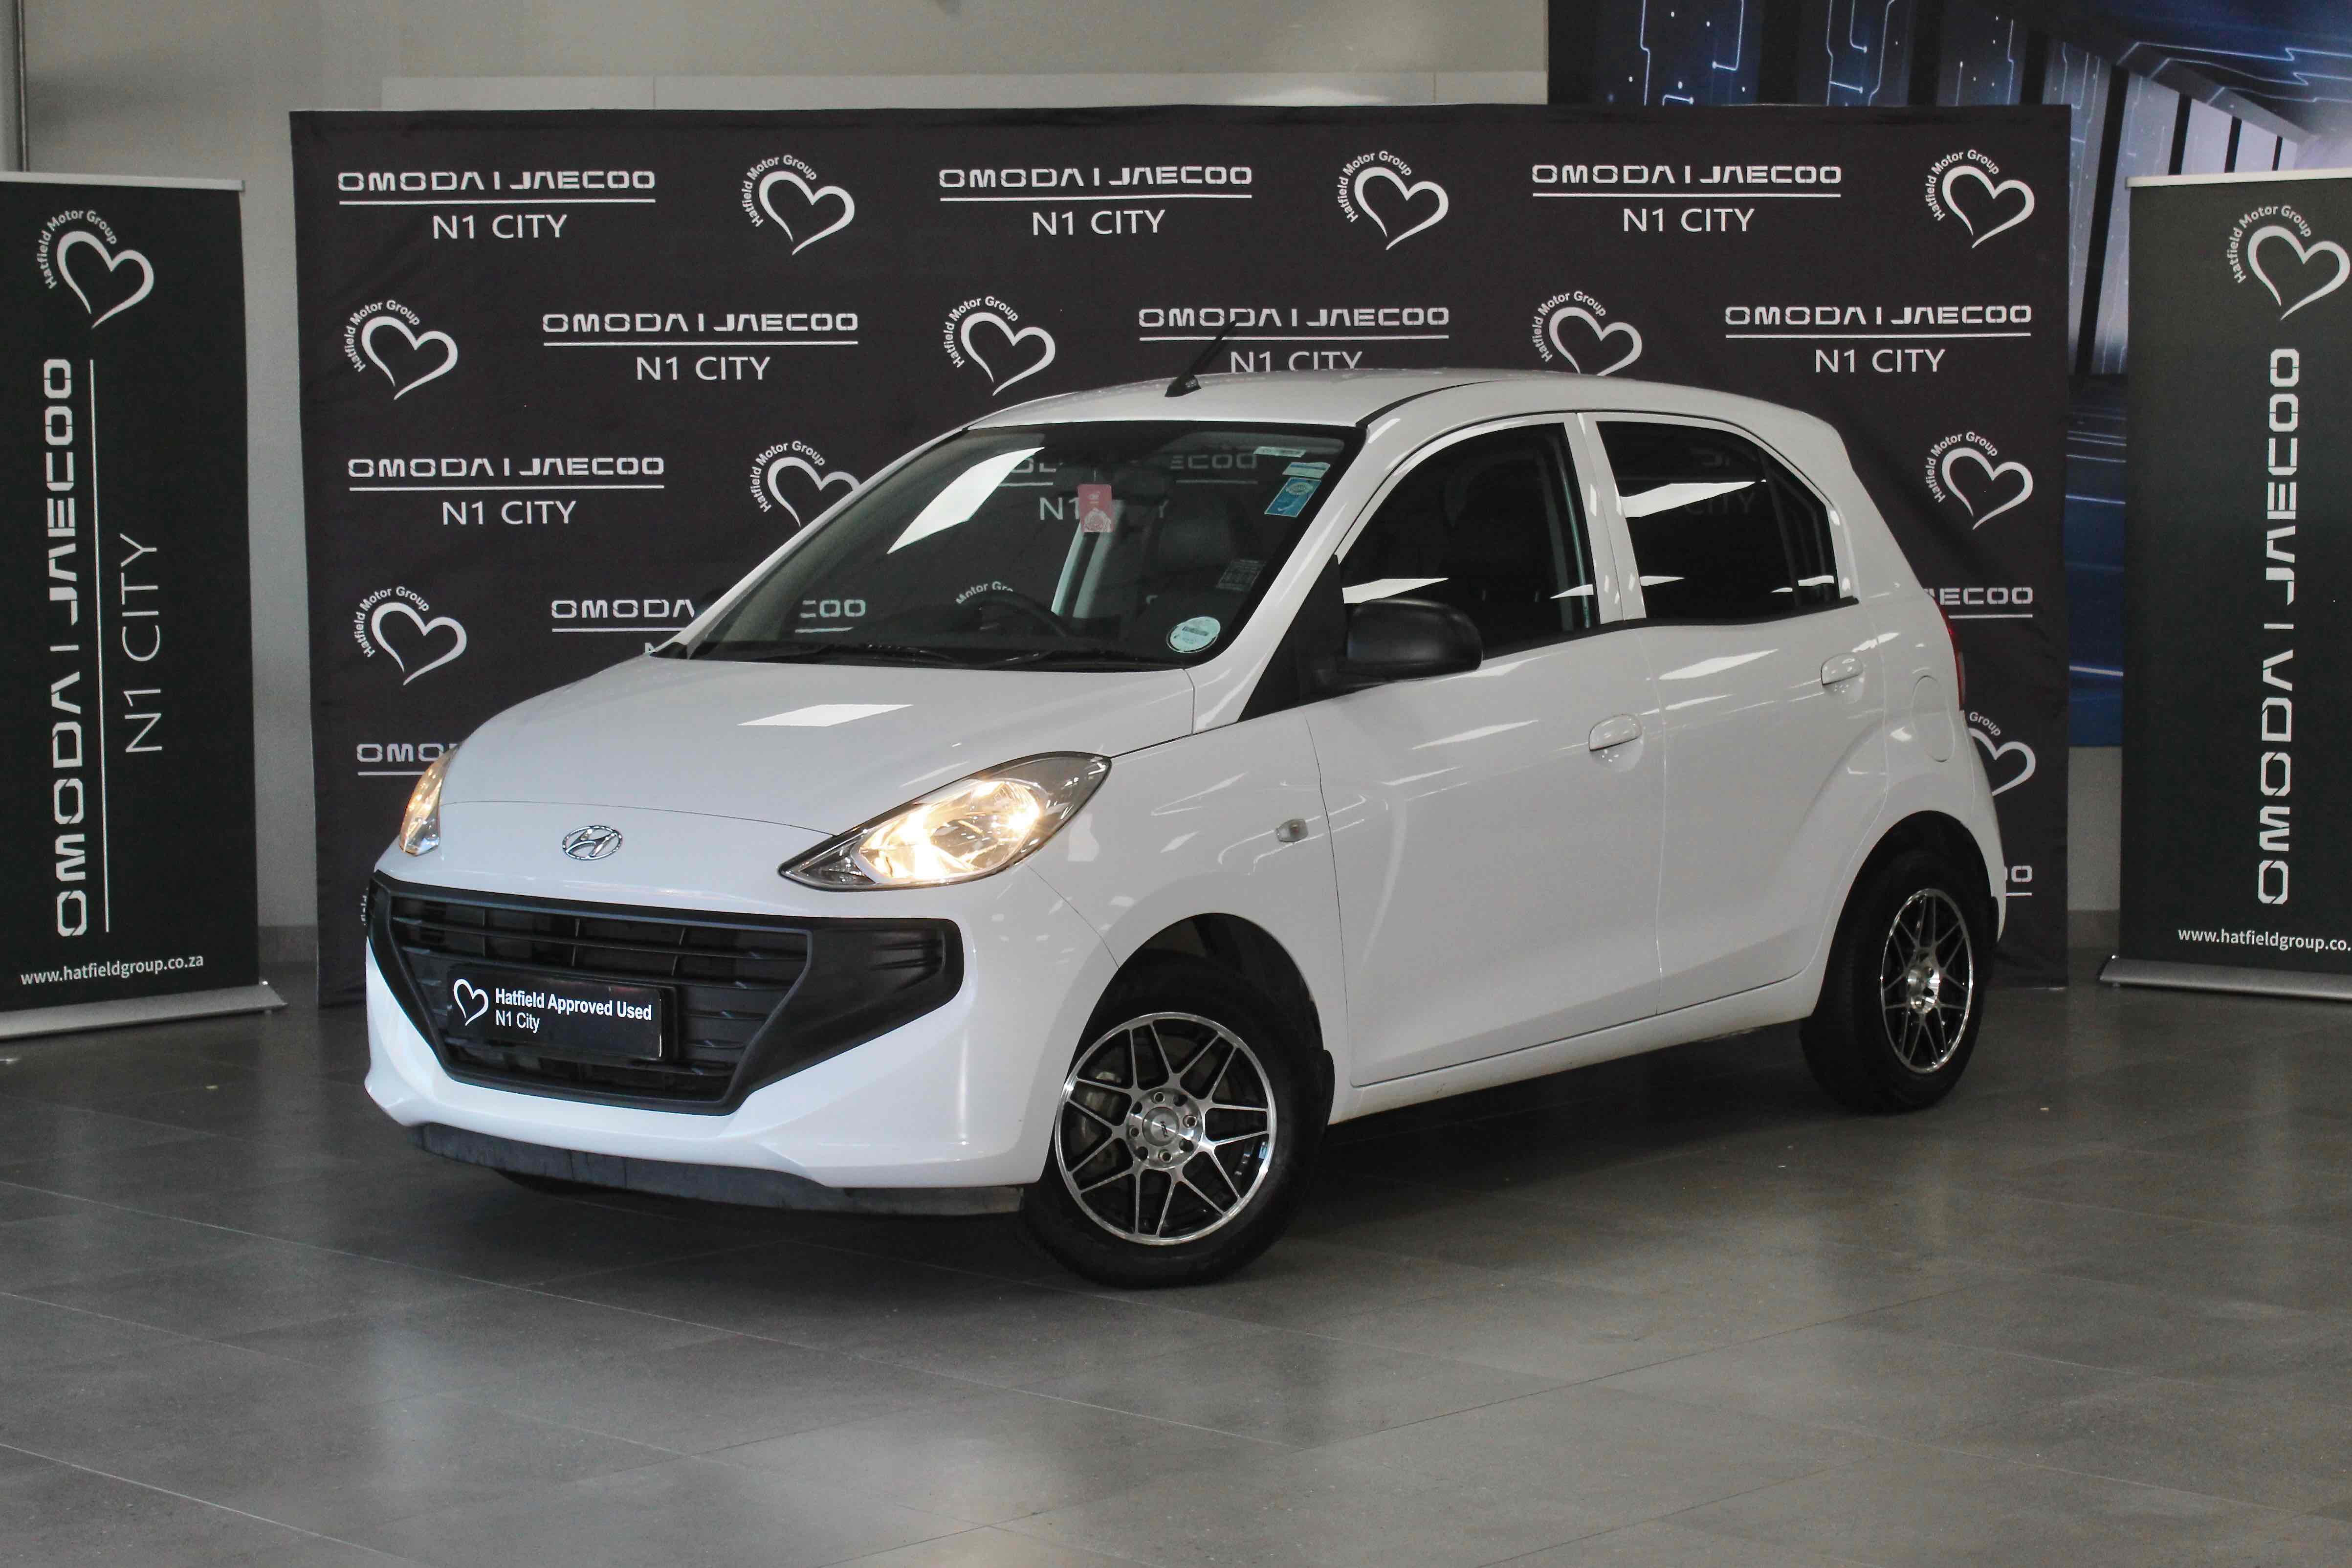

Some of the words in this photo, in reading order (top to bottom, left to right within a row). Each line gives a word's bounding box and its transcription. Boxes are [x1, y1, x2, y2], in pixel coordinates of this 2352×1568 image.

[747, 157, 779, 180] Motor
[784, 155, 816, 180] Group
[1343, 153, 1375, 176] Motor
[1379, 151, 1411, 176] Group
[1533, 165, 1675, 183] OMODA
[1700, 166, 1841, 183] JAECOO
[1932, 152, 1963, 174] Motor
[1967, 150, 1999, 174] Group
[338, 172, 484, 191] OMODA
[510, 171, 655, 189] JAECOO
[940, 168, 1084, 187] OMODA
[1109, 166, 1252, 185] JAECOO
[742, 181, 763, 227] Hatfield
[1338, 177, 1358, 222] Hatfield
[1926, 176, 1945, 221] Hatfield
[434, 215, 474, 239] N1
[492, 215, 567, 239] CITY
[1033, 212, 1073, 235] N1
[1091, 210, 1165, 234] CITY
[1624, 208, 1663, 231] N1
[1681, 209, 1755, 232] CITY
[37, 230, 57, 289] Hatfield
[47, 210, 84, 231] Motor
[87, 210, 117, 244] Group
[2227, 227, 2246, 284] Hatfield
[2239, 205, 2278, 228] Motor
[2281, 205, 2311, 238] Group
[350, 302, 382, 325] Motor
[387, 300, 419, 325] Group
[949, 298, 981, 321] Motor
[985, 296, 1018, 321] Group
[1538, 293, 1570, 315] Motor
[1574, 291, 1605, 316] Group
[1726, 307, 1866, 325] OMODA
[1891, 306, 2031, 324] JAECOO
[543, 314, 688, 332] OMODA
[714, 313, 857, 331] JAECOO
[1139, 309, 1281, 327] OMODA
[1306, 308, 1449, 326] JAECOO
[344, 326, 365, 372] Hatfield
[944, 322, 965, 368] Hatfield
[1532, 316, 1552, 362] Hatfield
[637, 357, 677, 380] N1
[696, 356, 770, 380] CITY
[1231, 352, 1270, 373] N1
[1288, 351, 1363, 372] CITY
[1816, 350, 1854, 372] N1
[1872, 349, 1945, 373] CITY
[756, 443, 788, 465] Motor
[792, 441, 825, 465] Group
[1931, 434, 1962, 456] Motor
[1966, 432, 1997, 456] Group
[348, 459, 494, 477] OMODA
[519, 458, 664, 475] JAECOO
[2266, 349, 2299, 605] JAECOO
[44, 359, 78, 625] JAECOO
[750, 467, 771, 512] Hatfield
[1926, 458, 1945, 502] Hatfield
[443, 501, 483, 525] N1
[502, 501, 576, 524] CITY
[120, 533, 160, 661] CITY
[359, 589, 391, 611] Motor
[396, 586, 429, 611] Group
[1924, 587, 2033, 605] ECOO
[551, 599, 695, 618] OMODA
[354, 612, 375, 657] Hatfield
[124, 689, 162, 752] N1
[1969, 711, 2001, 736] Group
[356, 743, 458, 762] OMO
[2258, 649, 2293, 904] OMODA
[51, 672, 87, 936] OMODA
[21, 956, 203, 985] www.hatfieldgroup.co.za
[496, 988, 544, 1009] Hatfield
[548, 994, 612, 1016] Approved
[617, 1001, 651, 1020] Used
[496, 1010, 511, 1026] N1
[517, 1013, 540, 1033] City
